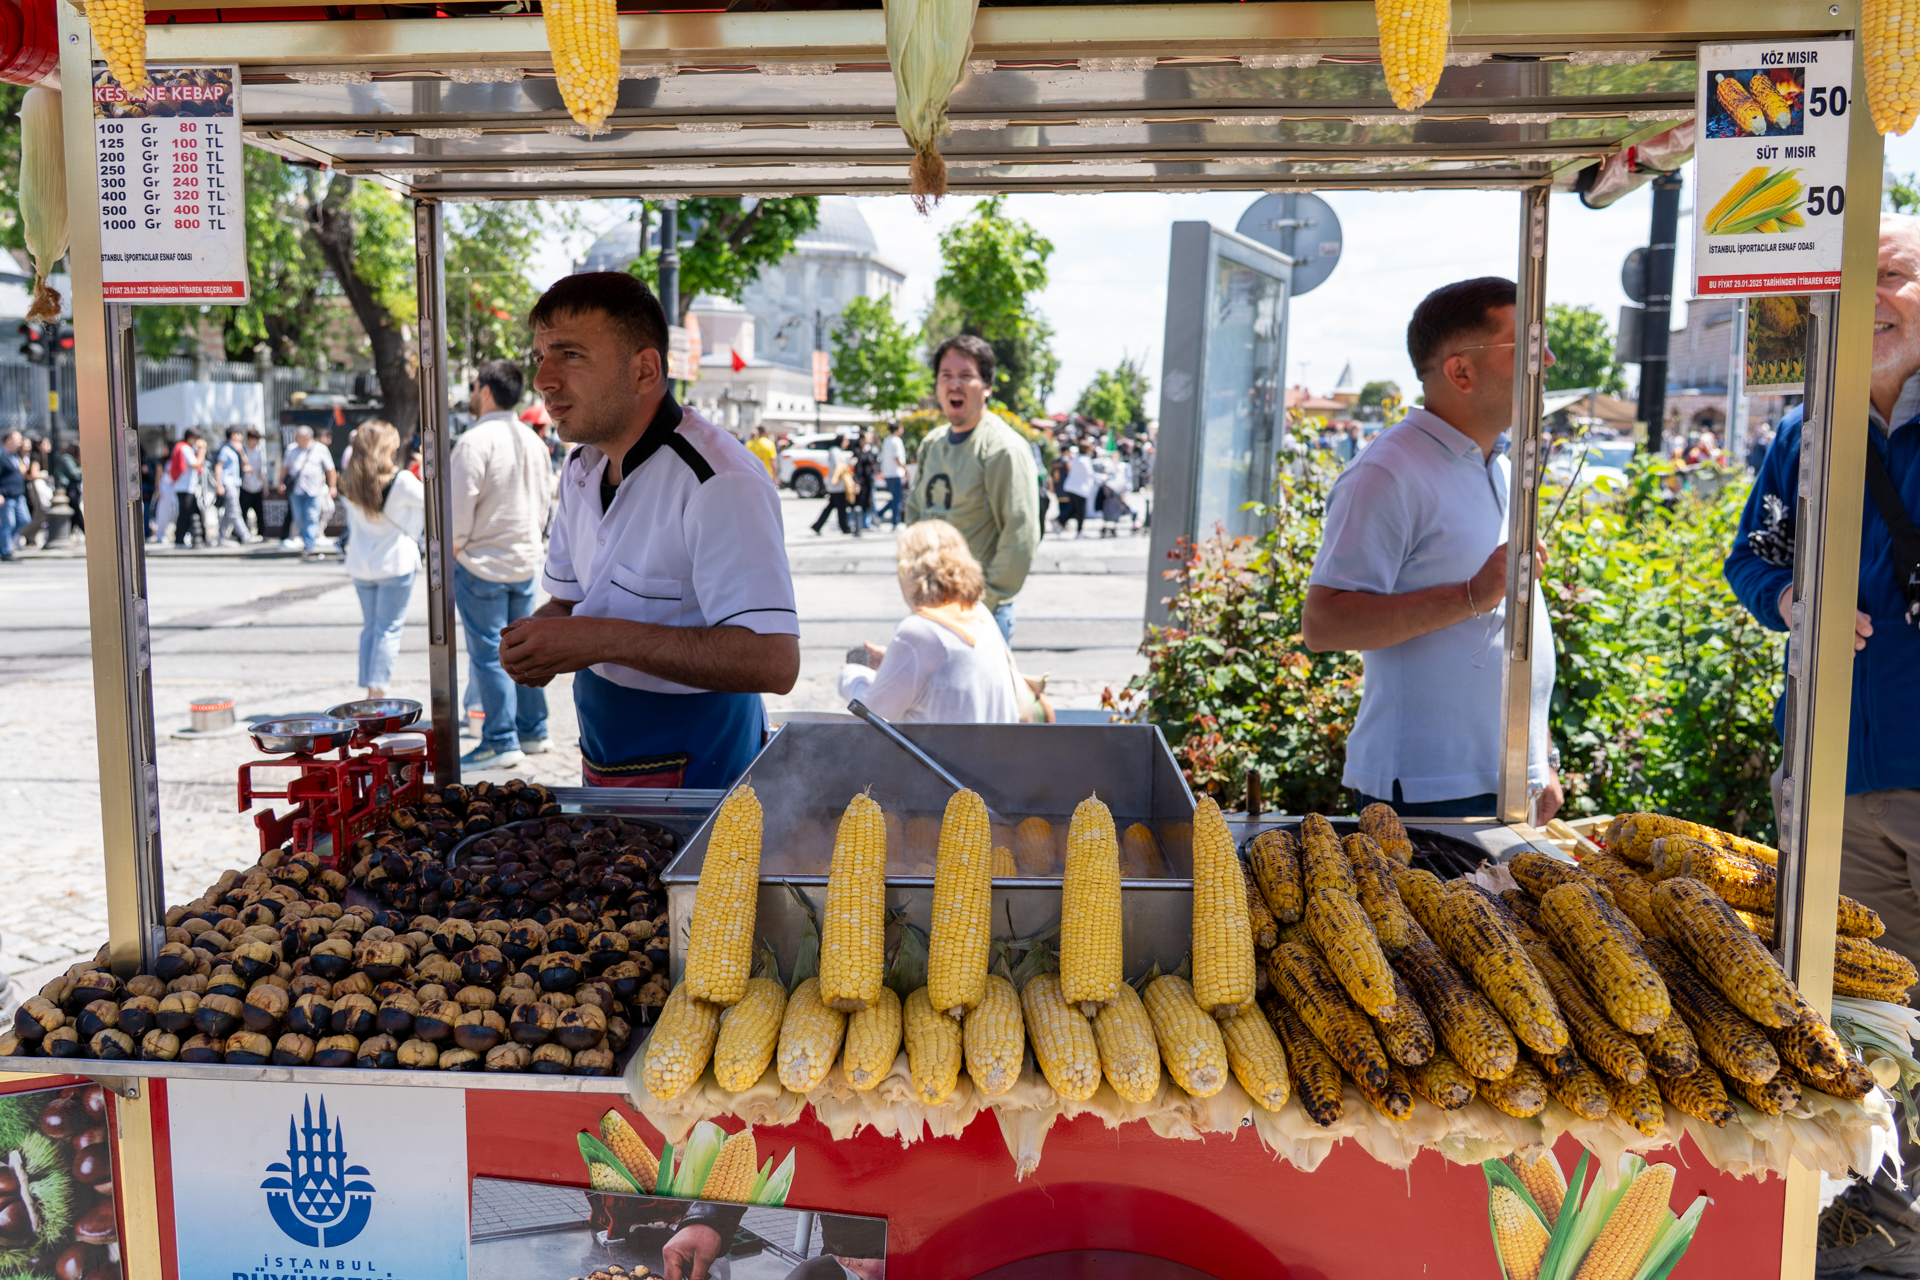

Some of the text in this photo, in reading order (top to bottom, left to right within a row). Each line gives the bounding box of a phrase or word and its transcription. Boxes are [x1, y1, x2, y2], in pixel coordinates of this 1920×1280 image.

[1762, 50, 1818, 65] KÖZ MISIR
[94, 86, 224, 102] KESTNE KEBAP
[99, 123, 224, 134] 100 Gr 80 TL
[100, 137, 224, 148] 125 Gr 100 TL
[100, 151, 225, 162] 200 Gr 160 TL
[1757, 145, 1816, 159] SÜT MISIR
[101, 163, 225, 175] 250 Gr 200 TL
[101, 177, 226, 188] 300 Gr 240 TL
[102, 190, 226, 201] 400 Gr 320 TL
[1806, 185, 1845, 216] 50
[103, 204, 226, 215] 500 Gr 400 TL
[103, 219, 226, 229] 1000 Gr 800 TL
[1709, 244, 1736, 254] İSTANBUL
[1778, 242, 1796, 251] ESNAF
[1798, 242, 1815, 250] ODASI
[160, 253, 176, 261] ESNAF
[1718, 279, 1733, 288] FİYAT
[1734, 279, 1762, 287] 29.01.2025
[1764, 277, 1796, 286] TARİHİNDEN
[1798, 276, 1823, 285] İTİBAREN
[110, 286, 122, 294] FİYAT
[124, 286, 148, 294] 29.01.2025
[149, 285, 178, 294] TARİHİNDEN
[180, 285, 203, 294] İTİBAREN
[264, 1253, 376, 1271] İSTANBUL
